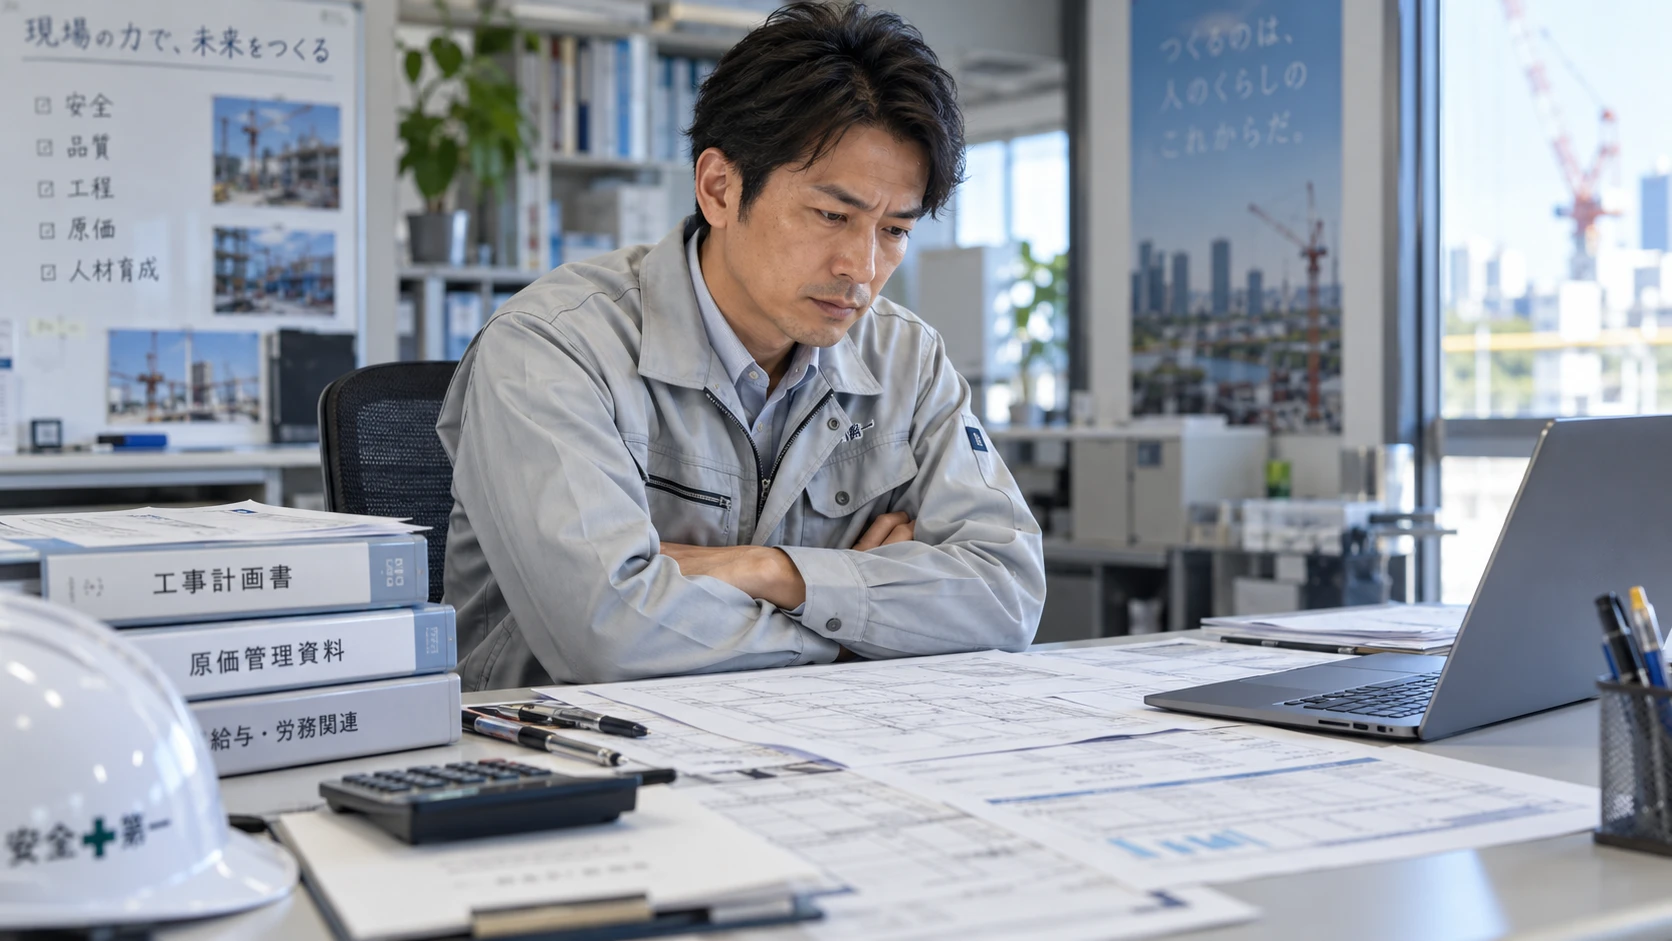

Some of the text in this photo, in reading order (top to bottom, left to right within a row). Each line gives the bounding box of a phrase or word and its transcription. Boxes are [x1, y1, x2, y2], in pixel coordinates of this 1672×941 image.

[24, 16, 331, 64] 現場の力で、未来をつくる
[1160, 15, 1293, 64] つくるのは、
[65, 92, 114, 119] 安全
[1159, 61, 1308, 113] 人のくらしの
[66, 134, 110, 161] 品質
[1160, 109, 1304, 159] これからだ。
[67, 177, 115, 200] 工程
[67, 217, 116, 241] 原価
[69, 257, 160, 284] 人材育成
[153, 564, 293, 596] 工事計画書
[189, 638, 345, 678] 原価管理資料
[204, 711, 359, 751] 給与・労務関連
[6, 812, 171, 868] 安全 第一
